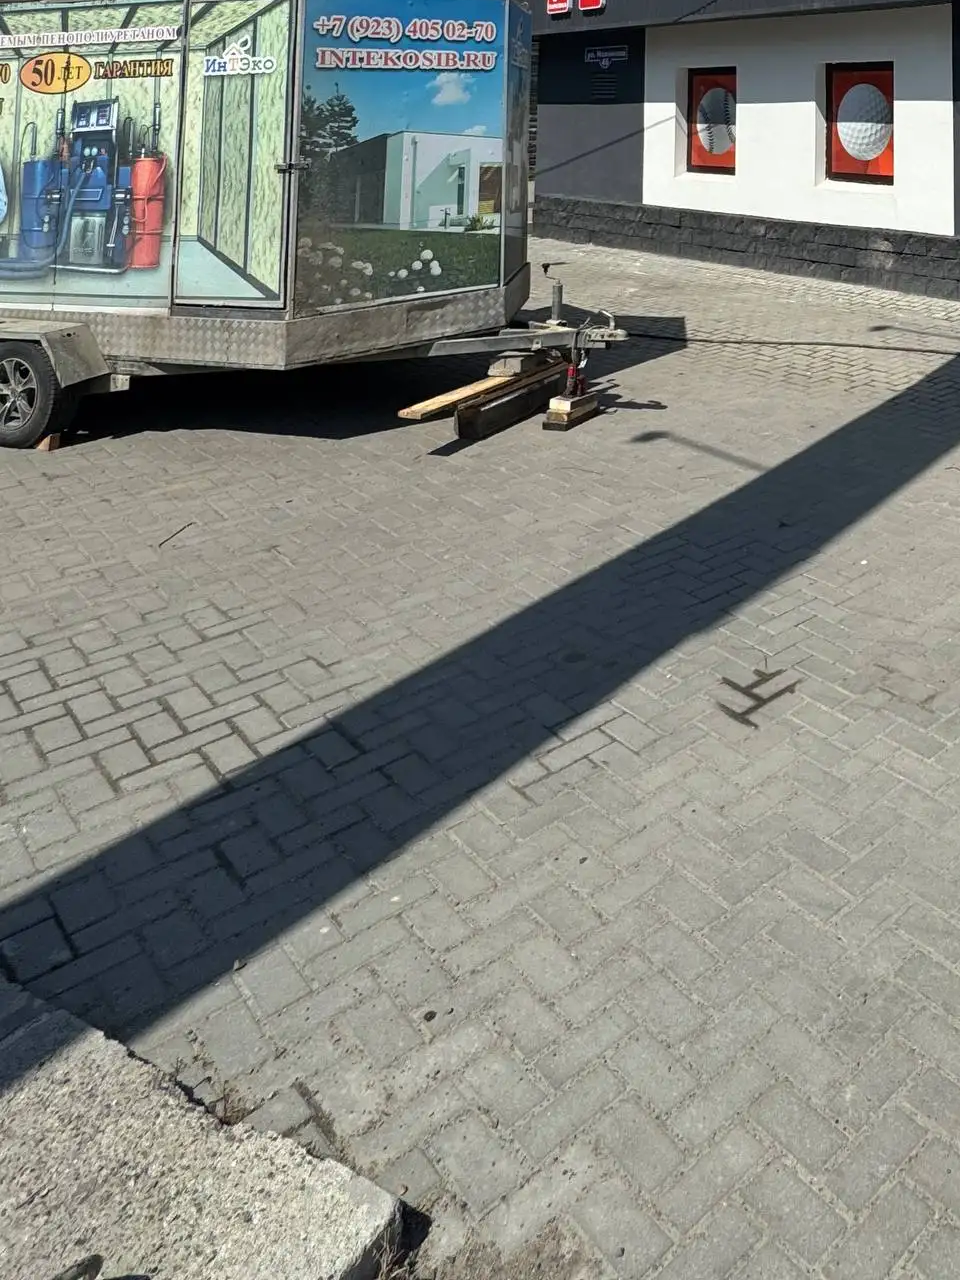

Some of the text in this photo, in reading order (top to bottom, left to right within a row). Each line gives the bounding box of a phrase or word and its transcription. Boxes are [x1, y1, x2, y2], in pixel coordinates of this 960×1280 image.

[40, 27, 177, 45] ПЕНОПОЛИУРЕТАНОМ
[315, 17, 496, 42] +7 (923) 405 02-70
[316, 48, 497, 69] INTEKOSIB.RU
[32, 58, 55, 87] 50
[58, 66, 83, 81] ЛЕТ
[94, 58, 174, 79] ГАРАНТИЯ
